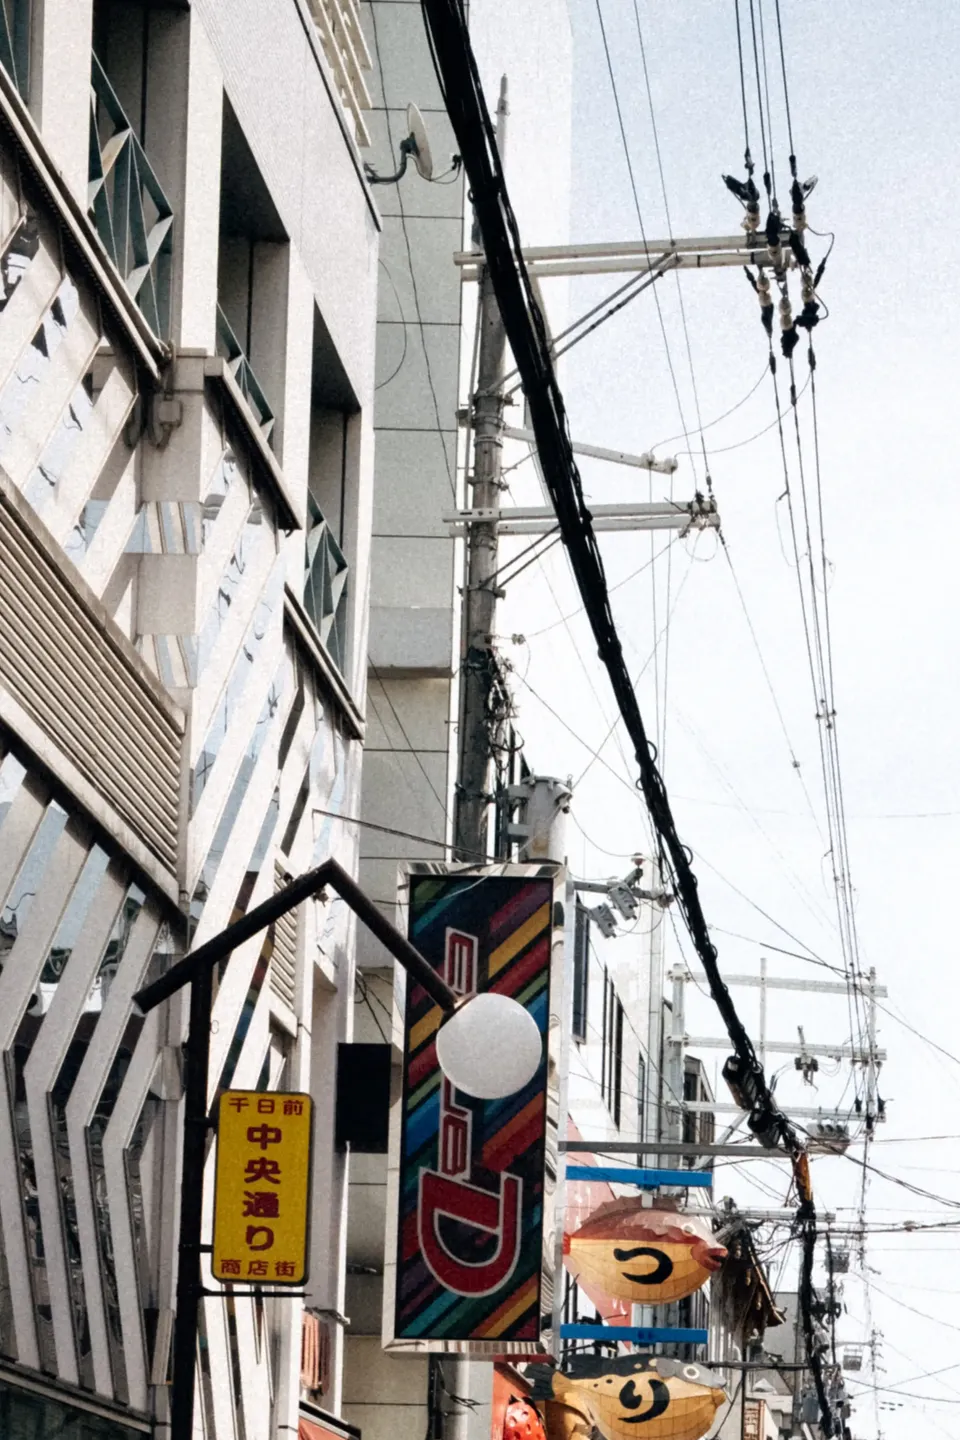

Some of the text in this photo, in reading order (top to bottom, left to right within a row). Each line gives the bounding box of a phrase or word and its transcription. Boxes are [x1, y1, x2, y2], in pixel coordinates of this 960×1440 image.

[228, 1097, 304, 1116] 千日前
[242, 1123, 282, 1251] 中央通り
[220, 1259, 296, 1277] 商店街
[613, 1247, 674, 1285] つ
[617, 1379, 671, 1424] り
